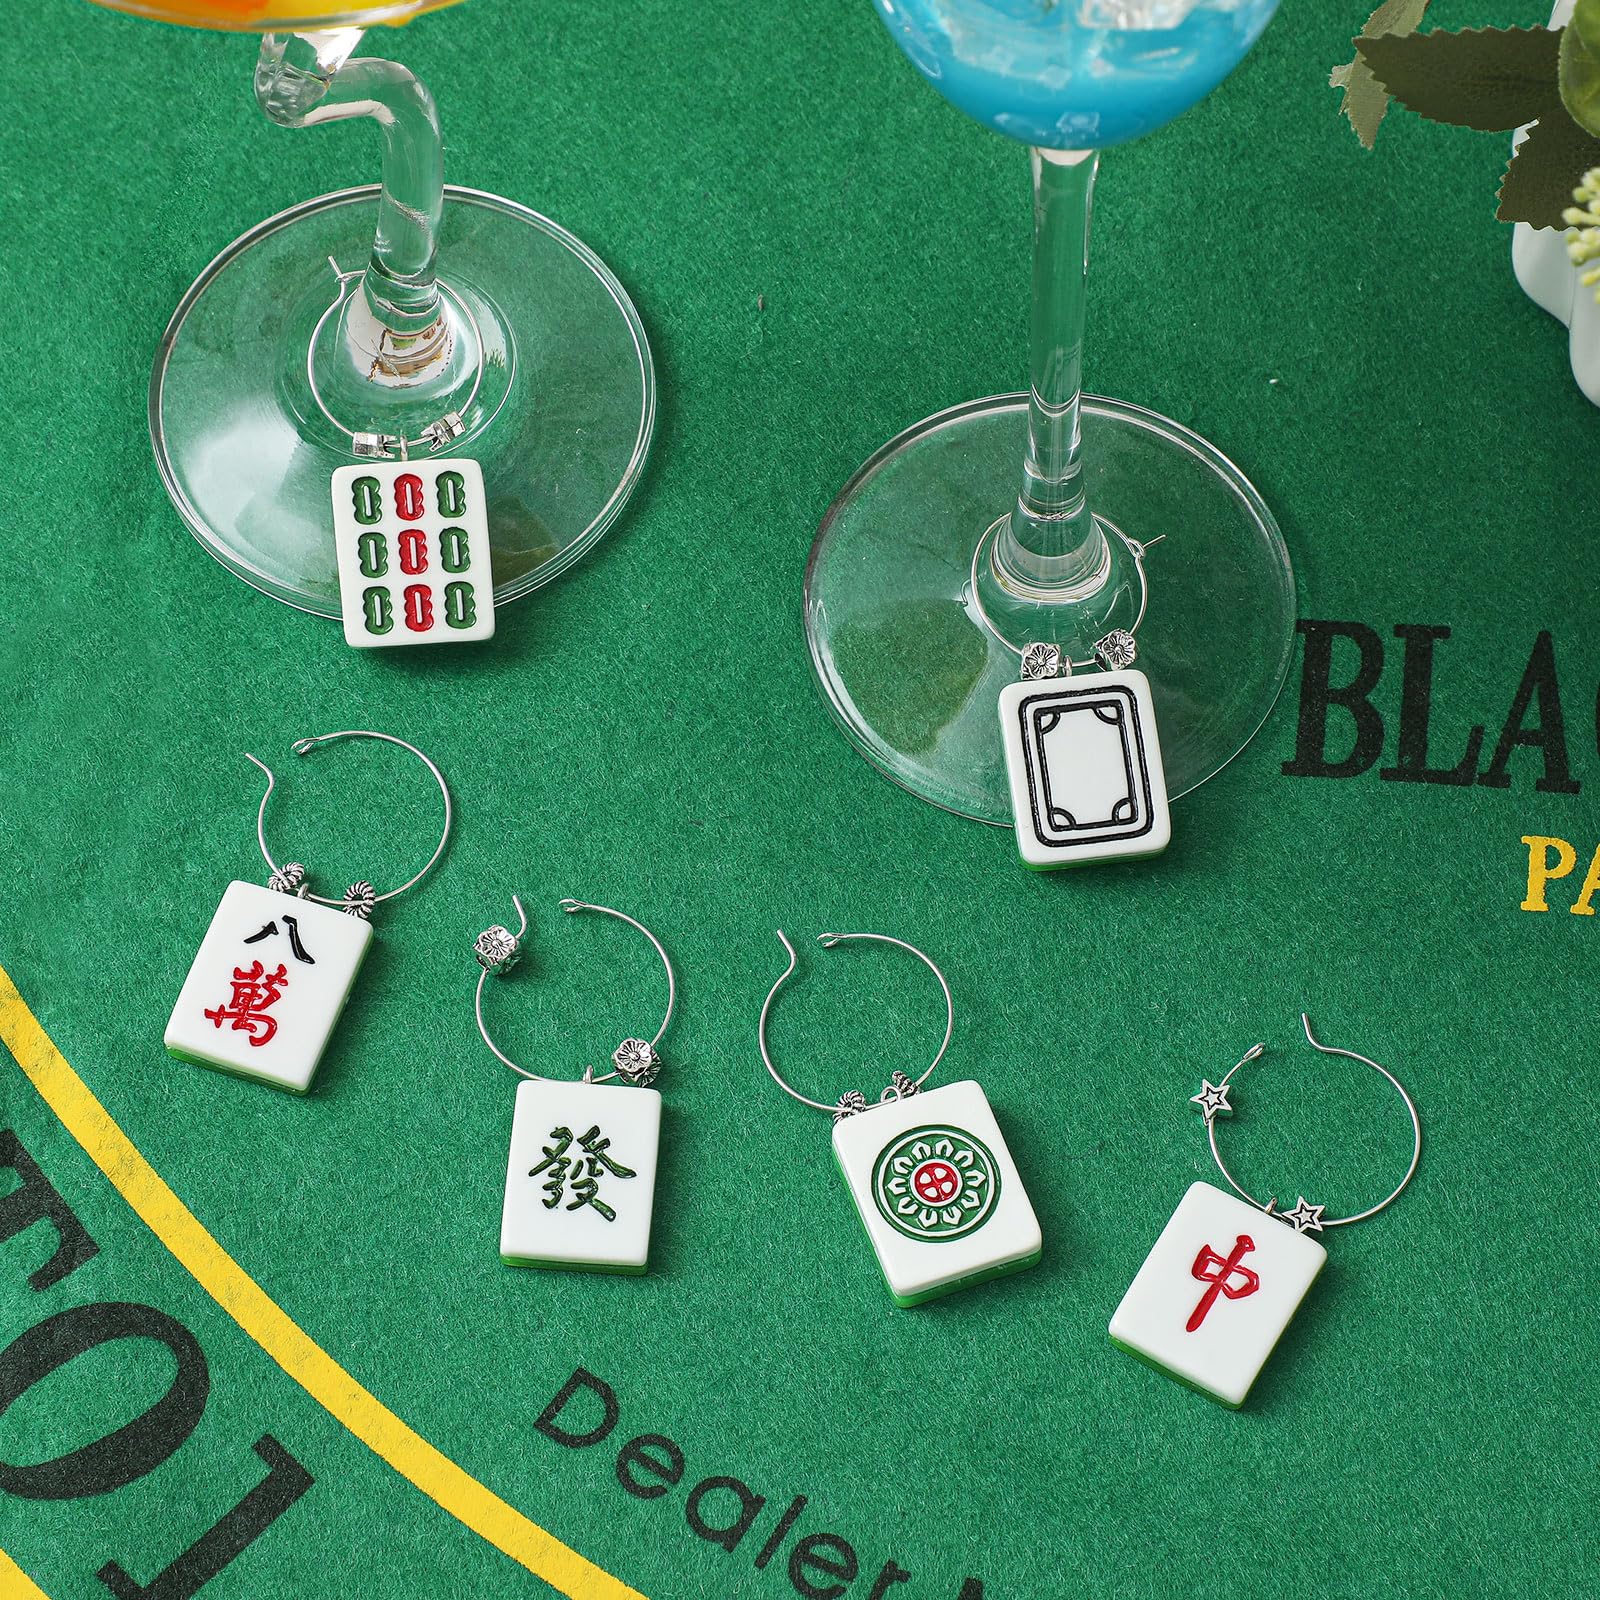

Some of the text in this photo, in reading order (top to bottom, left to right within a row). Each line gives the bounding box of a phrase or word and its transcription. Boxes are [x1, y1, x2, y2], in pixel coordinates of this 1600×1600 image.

[1281, 618, 1600, 794] BLA
[527, 1125, 637, 1222] 發
[1185, 1234, 1261, 1333] 中
[533, 1367, 911, 1600] Dealer
